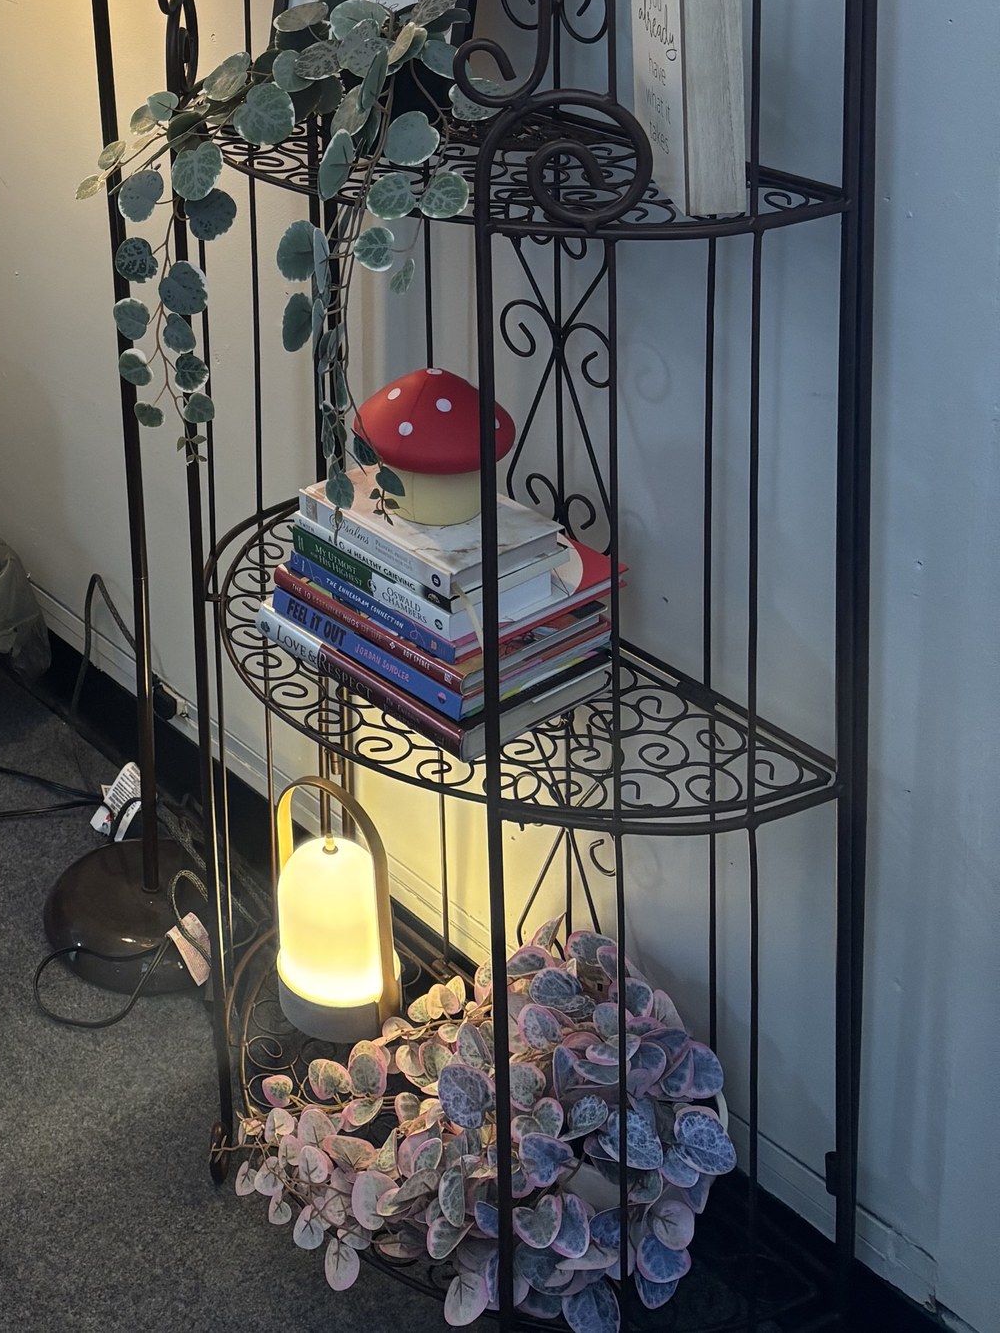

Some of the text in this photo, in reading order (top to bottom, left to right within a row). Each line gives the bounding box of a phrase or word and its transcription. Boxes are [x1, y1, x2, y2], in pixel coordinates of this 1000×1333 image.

[648, 52, 666, 86] have
[645, 86, 672, 126] what it
[650, 119, 669, 155] takes
[315, 544, 326, 557] MY
[328, 551, 356, 574] UTMOST
[332, 562, 362, 586] HIGHEST
[353, 551, 382, 571] HEALTHY
[383, 568, 416, 591] GRIEVING
[292, 583, 302, 592] THE
[304, 591, 311, 599] 10
[342, 613, 360, 628] HUGS
[326, 578, 404, 629] THE ENNEAGRAM CONNECTION
[382, 592, 427, 624] CHAMBERS
[387, 587, 421, 612] OSWALD
[286, 598, 308, 625] FEEL
[323, 620, 346, 647] OUT
[277, 625, 373, 699] LOVE & RESPECT
[354, 644, 381, 665] JORDAN
